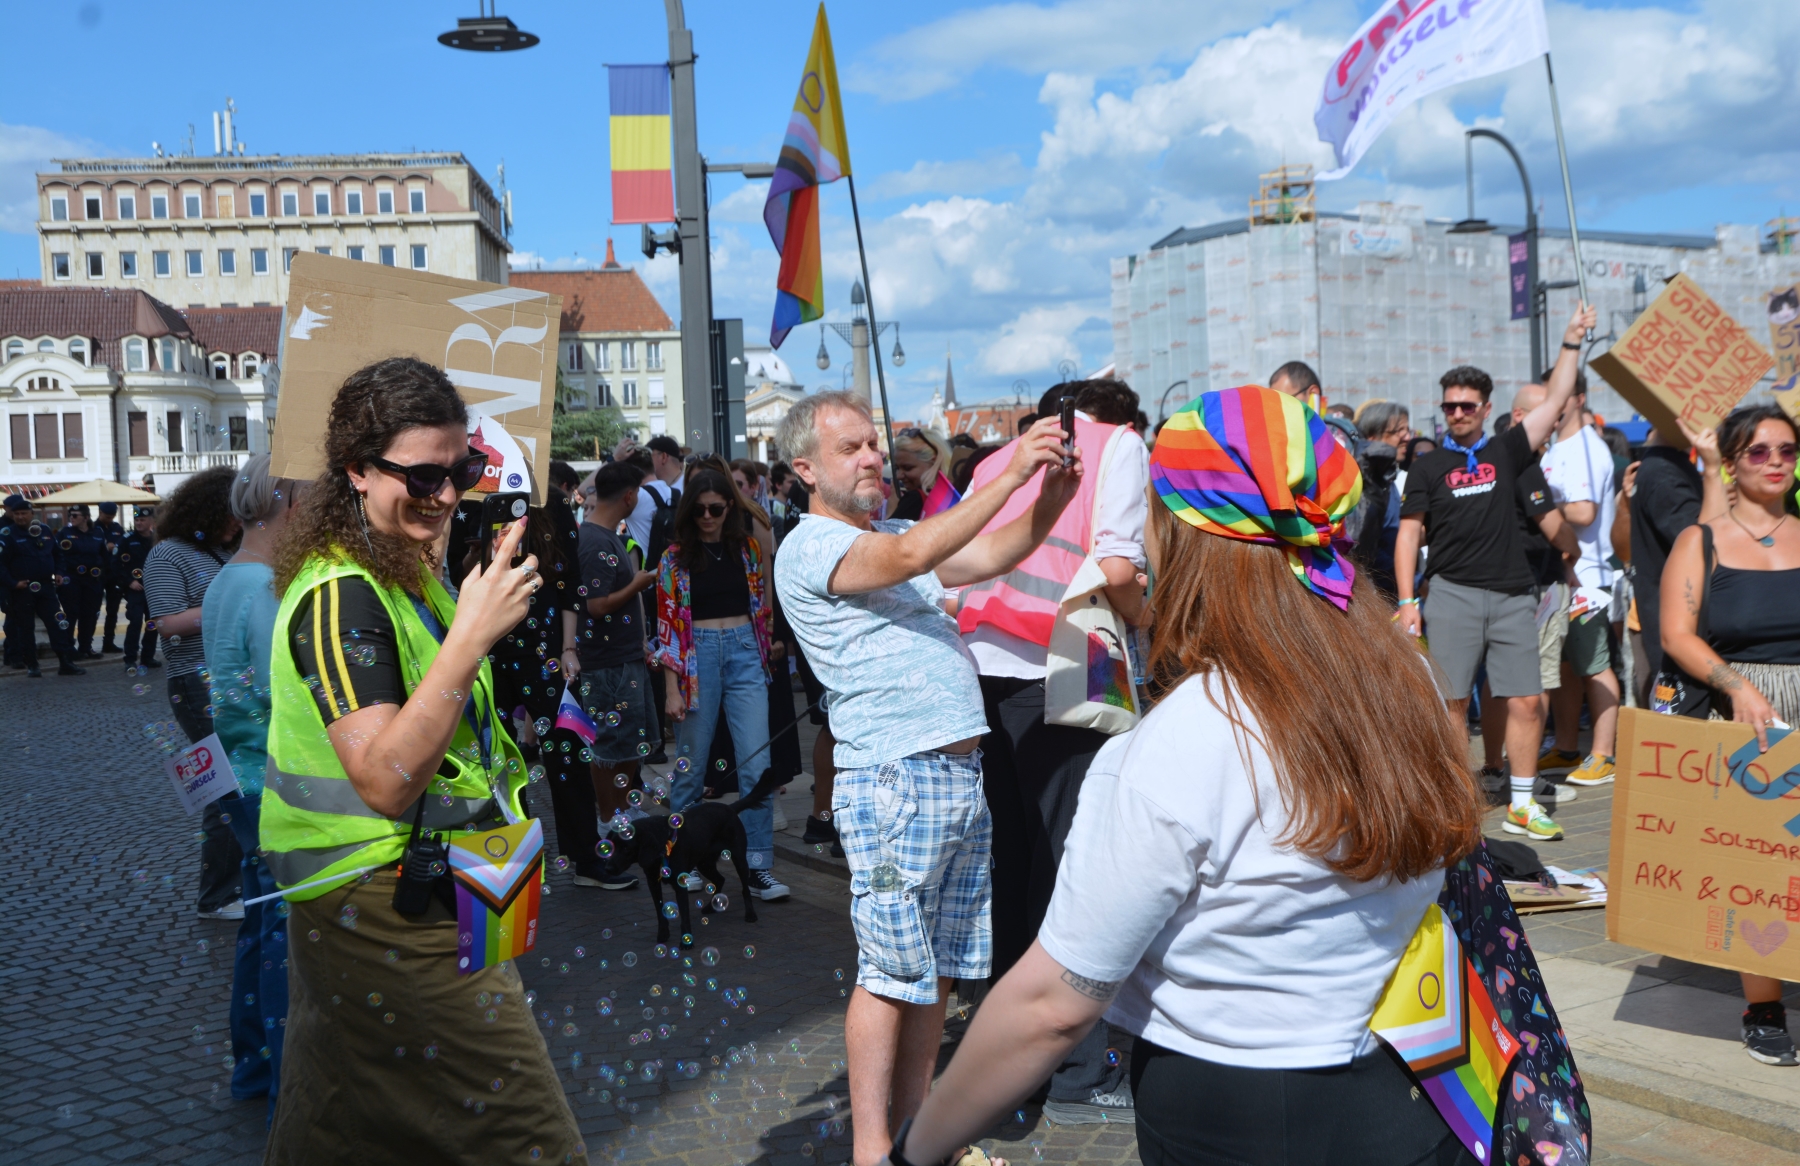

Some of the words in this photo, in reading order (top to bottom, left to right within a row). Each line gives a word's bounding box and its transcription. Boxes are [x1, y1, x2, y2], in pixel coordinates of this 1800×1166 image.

[1690, 297, 1722, 332] EU
[1619, 309, 1675, 365] VREM
[1664, 357, 1706, 401] NU
[1635, 813, 1676, 835] IN
[1699, 826, 1800, 861] SOLIDAR
[1635, 862, 1683, 892] ARK
[1697, 876, 1720, 901] &
[1728, 884, 1800, 912] ORAD
[1722, 929, 1735, 952] Easy
[1725, 908, 1736, 929] Safe
